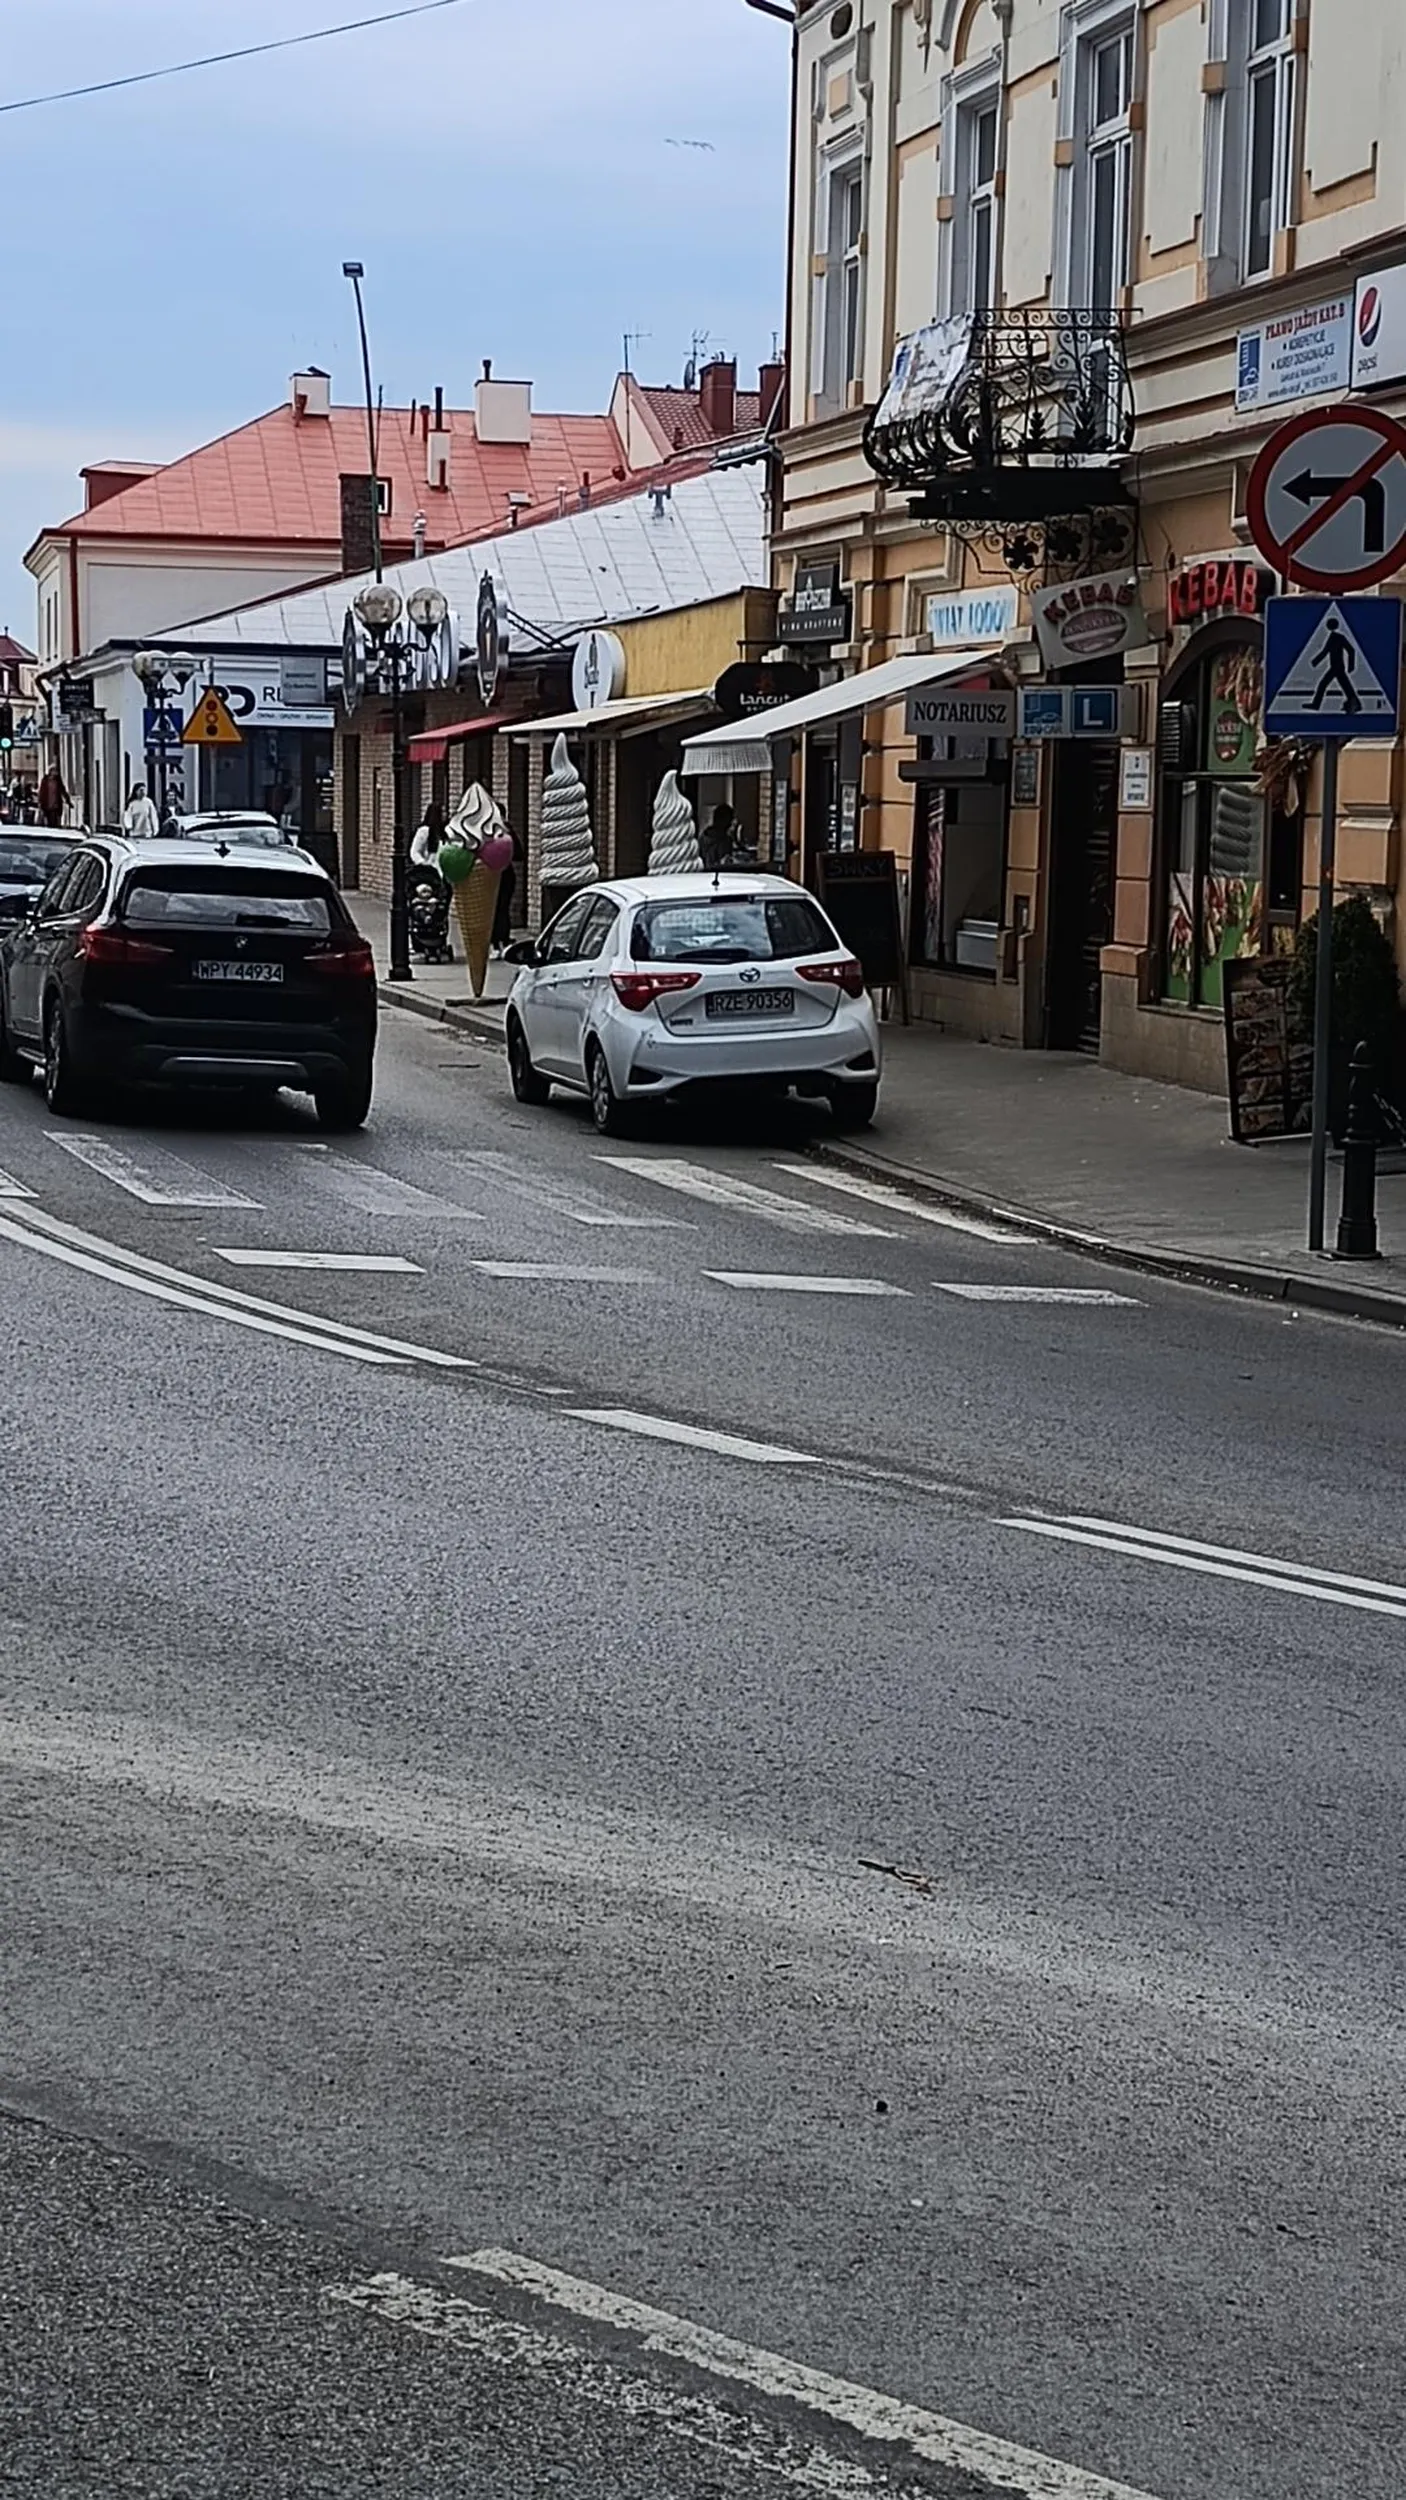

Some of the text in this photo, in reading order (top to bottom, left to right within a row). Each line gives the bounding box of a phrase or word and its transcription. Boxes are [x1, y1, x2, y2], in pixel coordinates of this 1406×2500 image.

[1043, 582, 1135, 625] KEBAB
[1168, 561, 1258, 626] KEBAB
[913, 700, 1007, 724] NOTARIUSZ
[1083, 698, 1104, 726] L
[200, 963, 283, 980] WPY 44934
[715, 991, 791, 1012] RZE 90356
